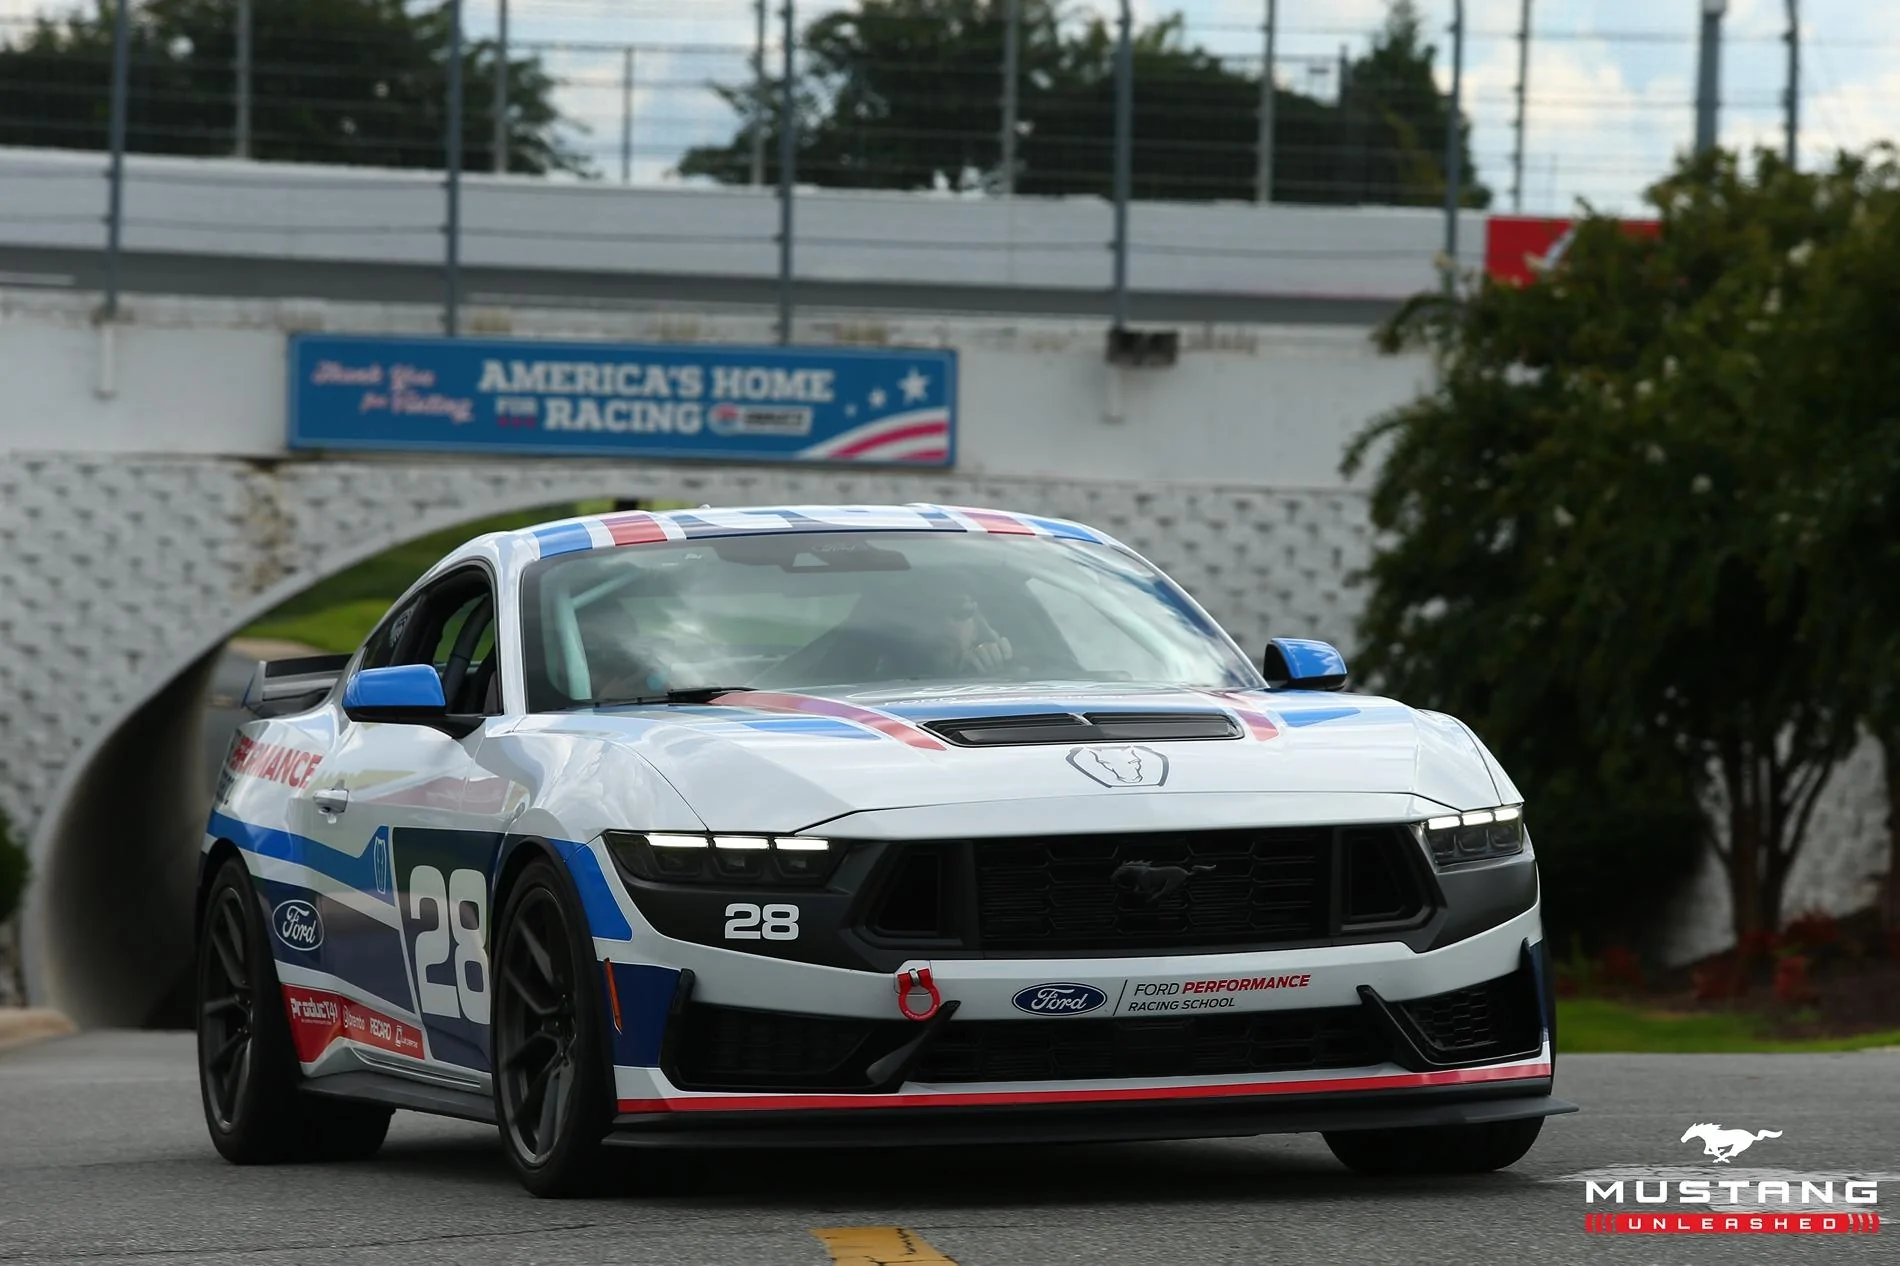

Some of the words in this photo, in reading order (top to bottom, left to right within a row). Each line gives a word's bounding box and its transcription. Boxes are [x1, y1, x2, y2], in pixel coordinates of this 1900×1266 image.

[477, 360, 703, 397] AMERICA'S
[711, 366, 834, 402] HOME
[543, 398, 703, 434] RACING
[281, 906, 316, 945] Ford
[724, 902, 800, 941] 28
[409, 864, 491, 1025] 28
[1030, 987, 1089, 1011] Ford
[1133, 982, 1180, 997] FORD
[1181, 974, 1311, 995] PERFORMANCE
[1127, 1000, 1179, 1012] RACING
[1181, 997, 1236, 1010] SCHOOL
[369, 1017, 392, 1041] RECARO
